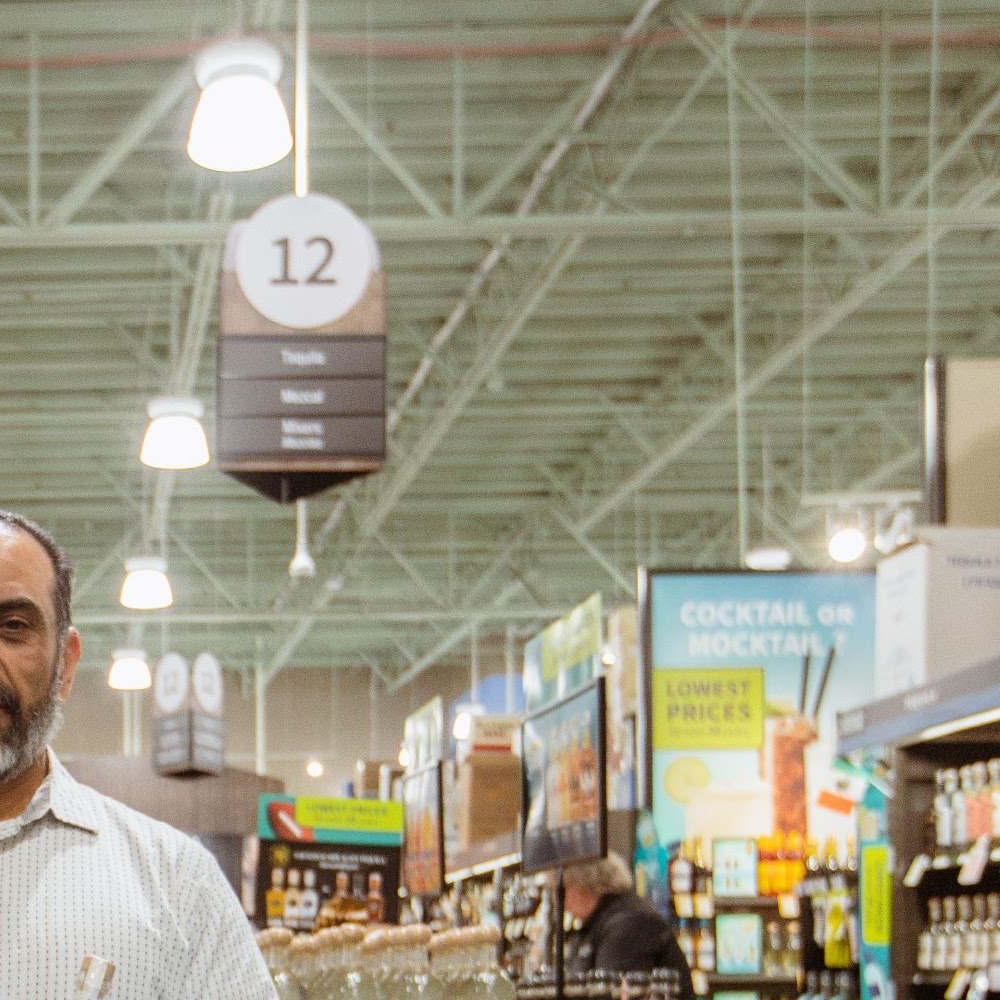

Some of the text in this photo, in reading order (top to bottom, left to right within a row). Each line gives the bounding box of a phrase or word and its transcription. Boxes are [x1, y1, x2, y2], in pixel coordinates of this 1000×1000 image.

[270, 236, 337, 285] 12
[680, 601, 855, 627] COCKTAIL OR
[687, 631, 825, 657] MOCKTAIL
[666, 680, 750, 698] LOWEST
[666, 702, 751, 722] PRICES
